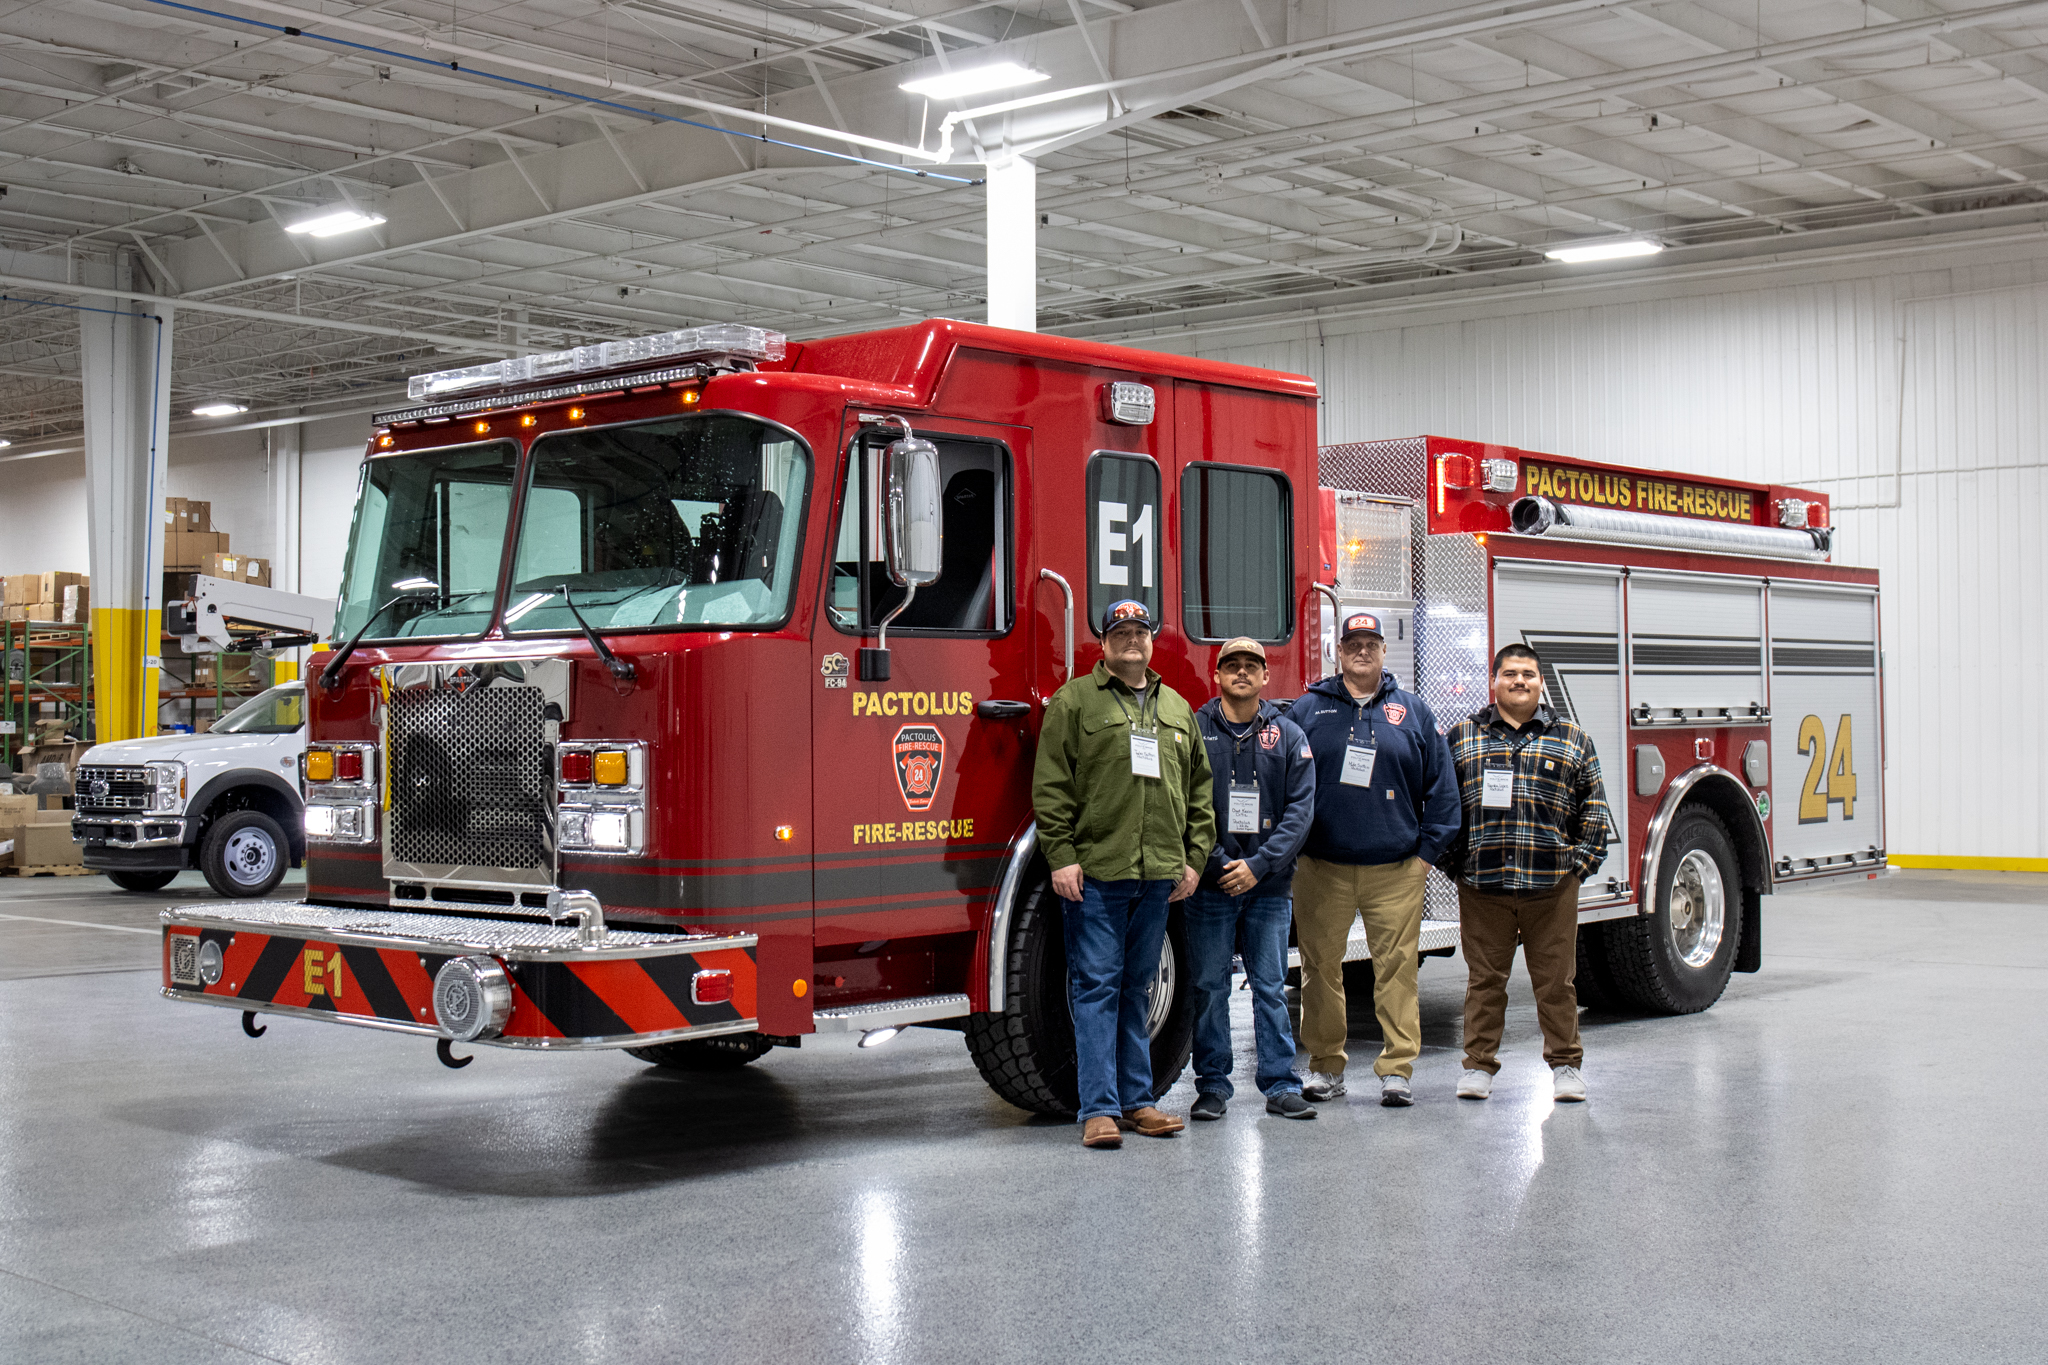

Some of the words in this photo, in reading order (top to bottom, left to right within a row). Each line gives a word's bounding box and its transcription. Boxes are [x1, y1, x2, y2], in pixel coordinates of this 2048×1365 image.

[1526, 465, 1632, 508] PACTOLUS
[1636, 480, 1752, 522] FIRE-RESCUE
[1098, 500, 1153, 588] E1
[1355, 618, 1368, 626] 24
[852, 691, 974, 717] PACTOLUS
[898, 742, 939, 752] FIRE-RESCUE
[901, 732, 936, 742] PACTOLUS
[914, 769, 923, 781] 24
[1797, 713, 1858, 825] 24
[853, 818, 974, 845] FIRE-RESCUE
[304, 949, 342, 998] E1
